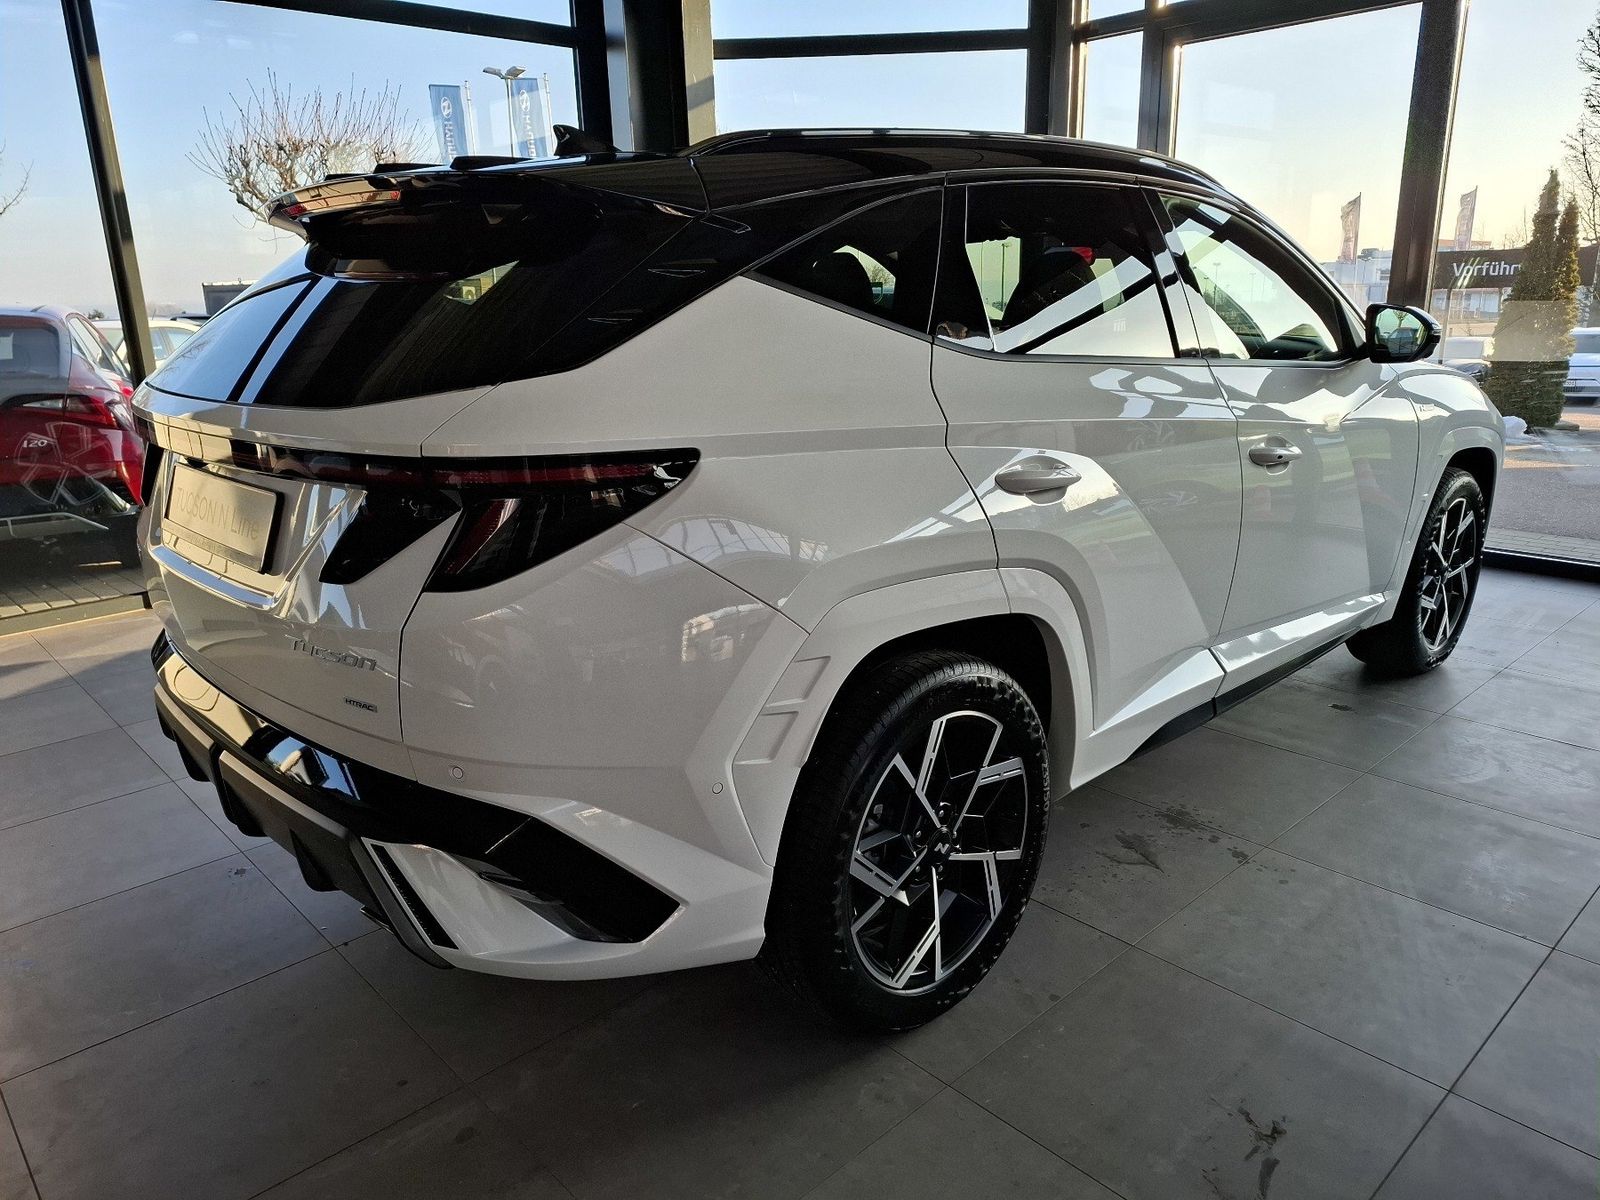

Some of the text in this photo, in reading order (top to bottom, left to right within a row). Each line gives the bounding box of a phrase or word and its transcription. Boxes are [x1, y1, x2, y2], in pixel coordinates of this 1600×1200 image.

[1452, 261, 1520, 277] Vorführ
[176, 486, 217, 524] TUCSON
[344, 697, 376, 712] HTRAC
